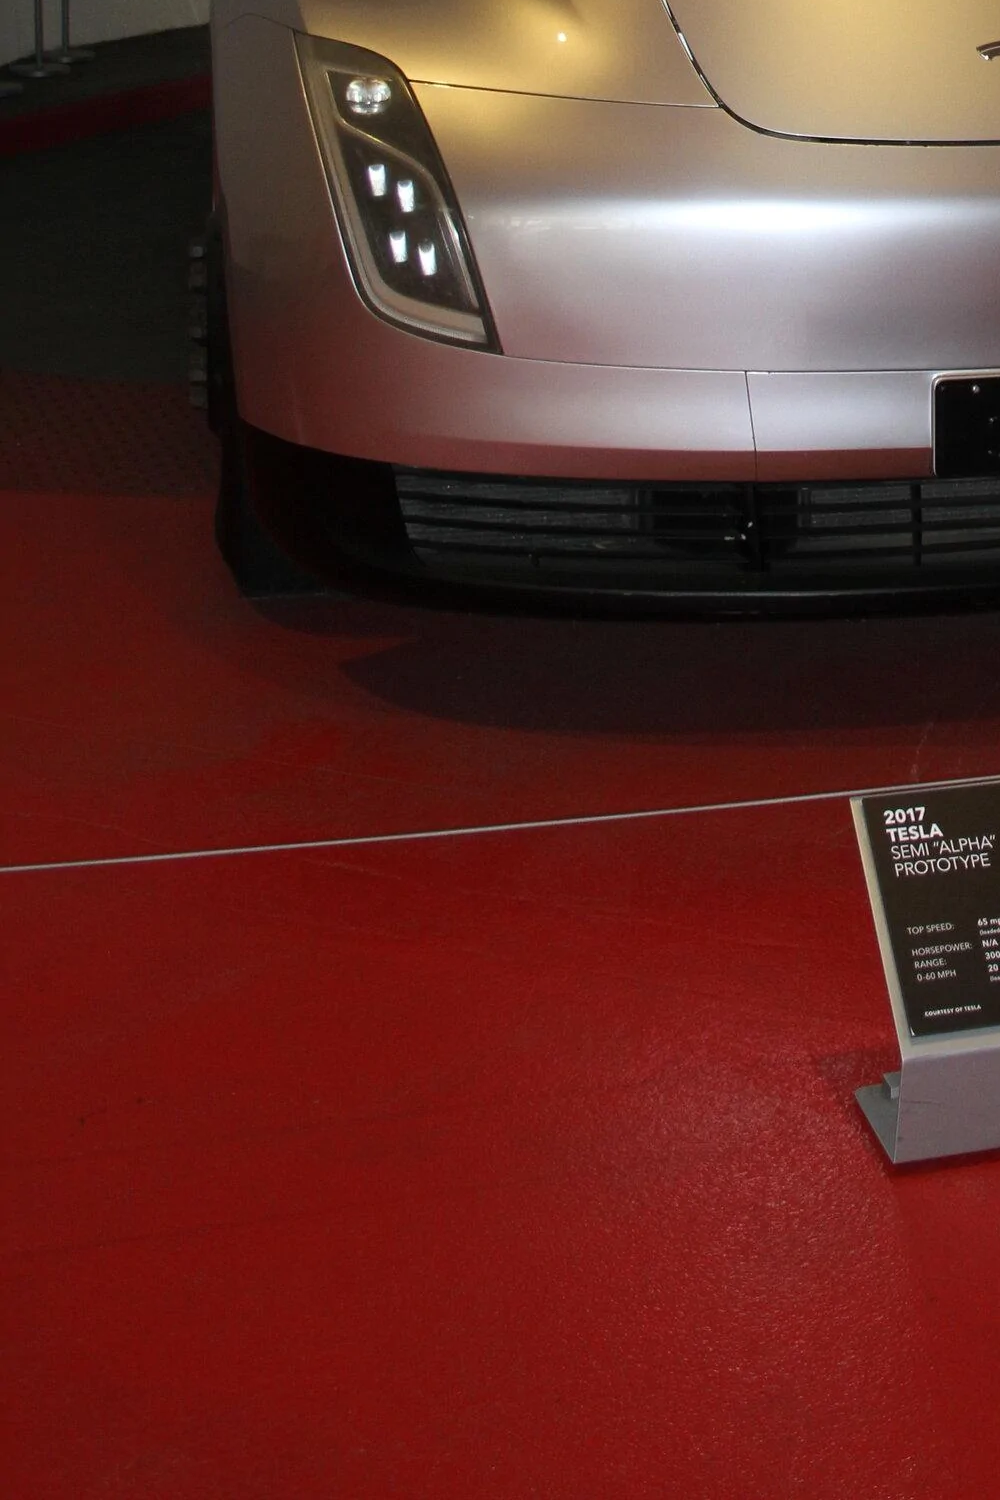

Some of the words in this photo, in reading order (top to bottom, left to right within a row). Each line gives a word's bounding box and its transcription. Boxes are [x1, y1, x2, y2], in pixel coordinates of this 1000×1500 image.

[883, 806, 925, 825] 2017
[886, 823, 944, 842] TESLA
[891, 842, 930, 860] SEMI
[894, 852, 991, 877] PROTOTYPE
[907, 925, 924, 935] TOP
[926, 922, 954, 933] SPEED:
[977, 917, 988, 927] 65
[911, 942, 972, 956] HORSEPOWER:
[982, 939, 999, 947] N/A
[985, 950, 1000, 960] 300
[914, 958, 947, 969] RANGE:
[988, 963, 999, 972] 20
[917, 971, 936, 982] 0-60
[937, 969, 957, 978] MPH
[924, 1008, 954, 1017] COURTESY
